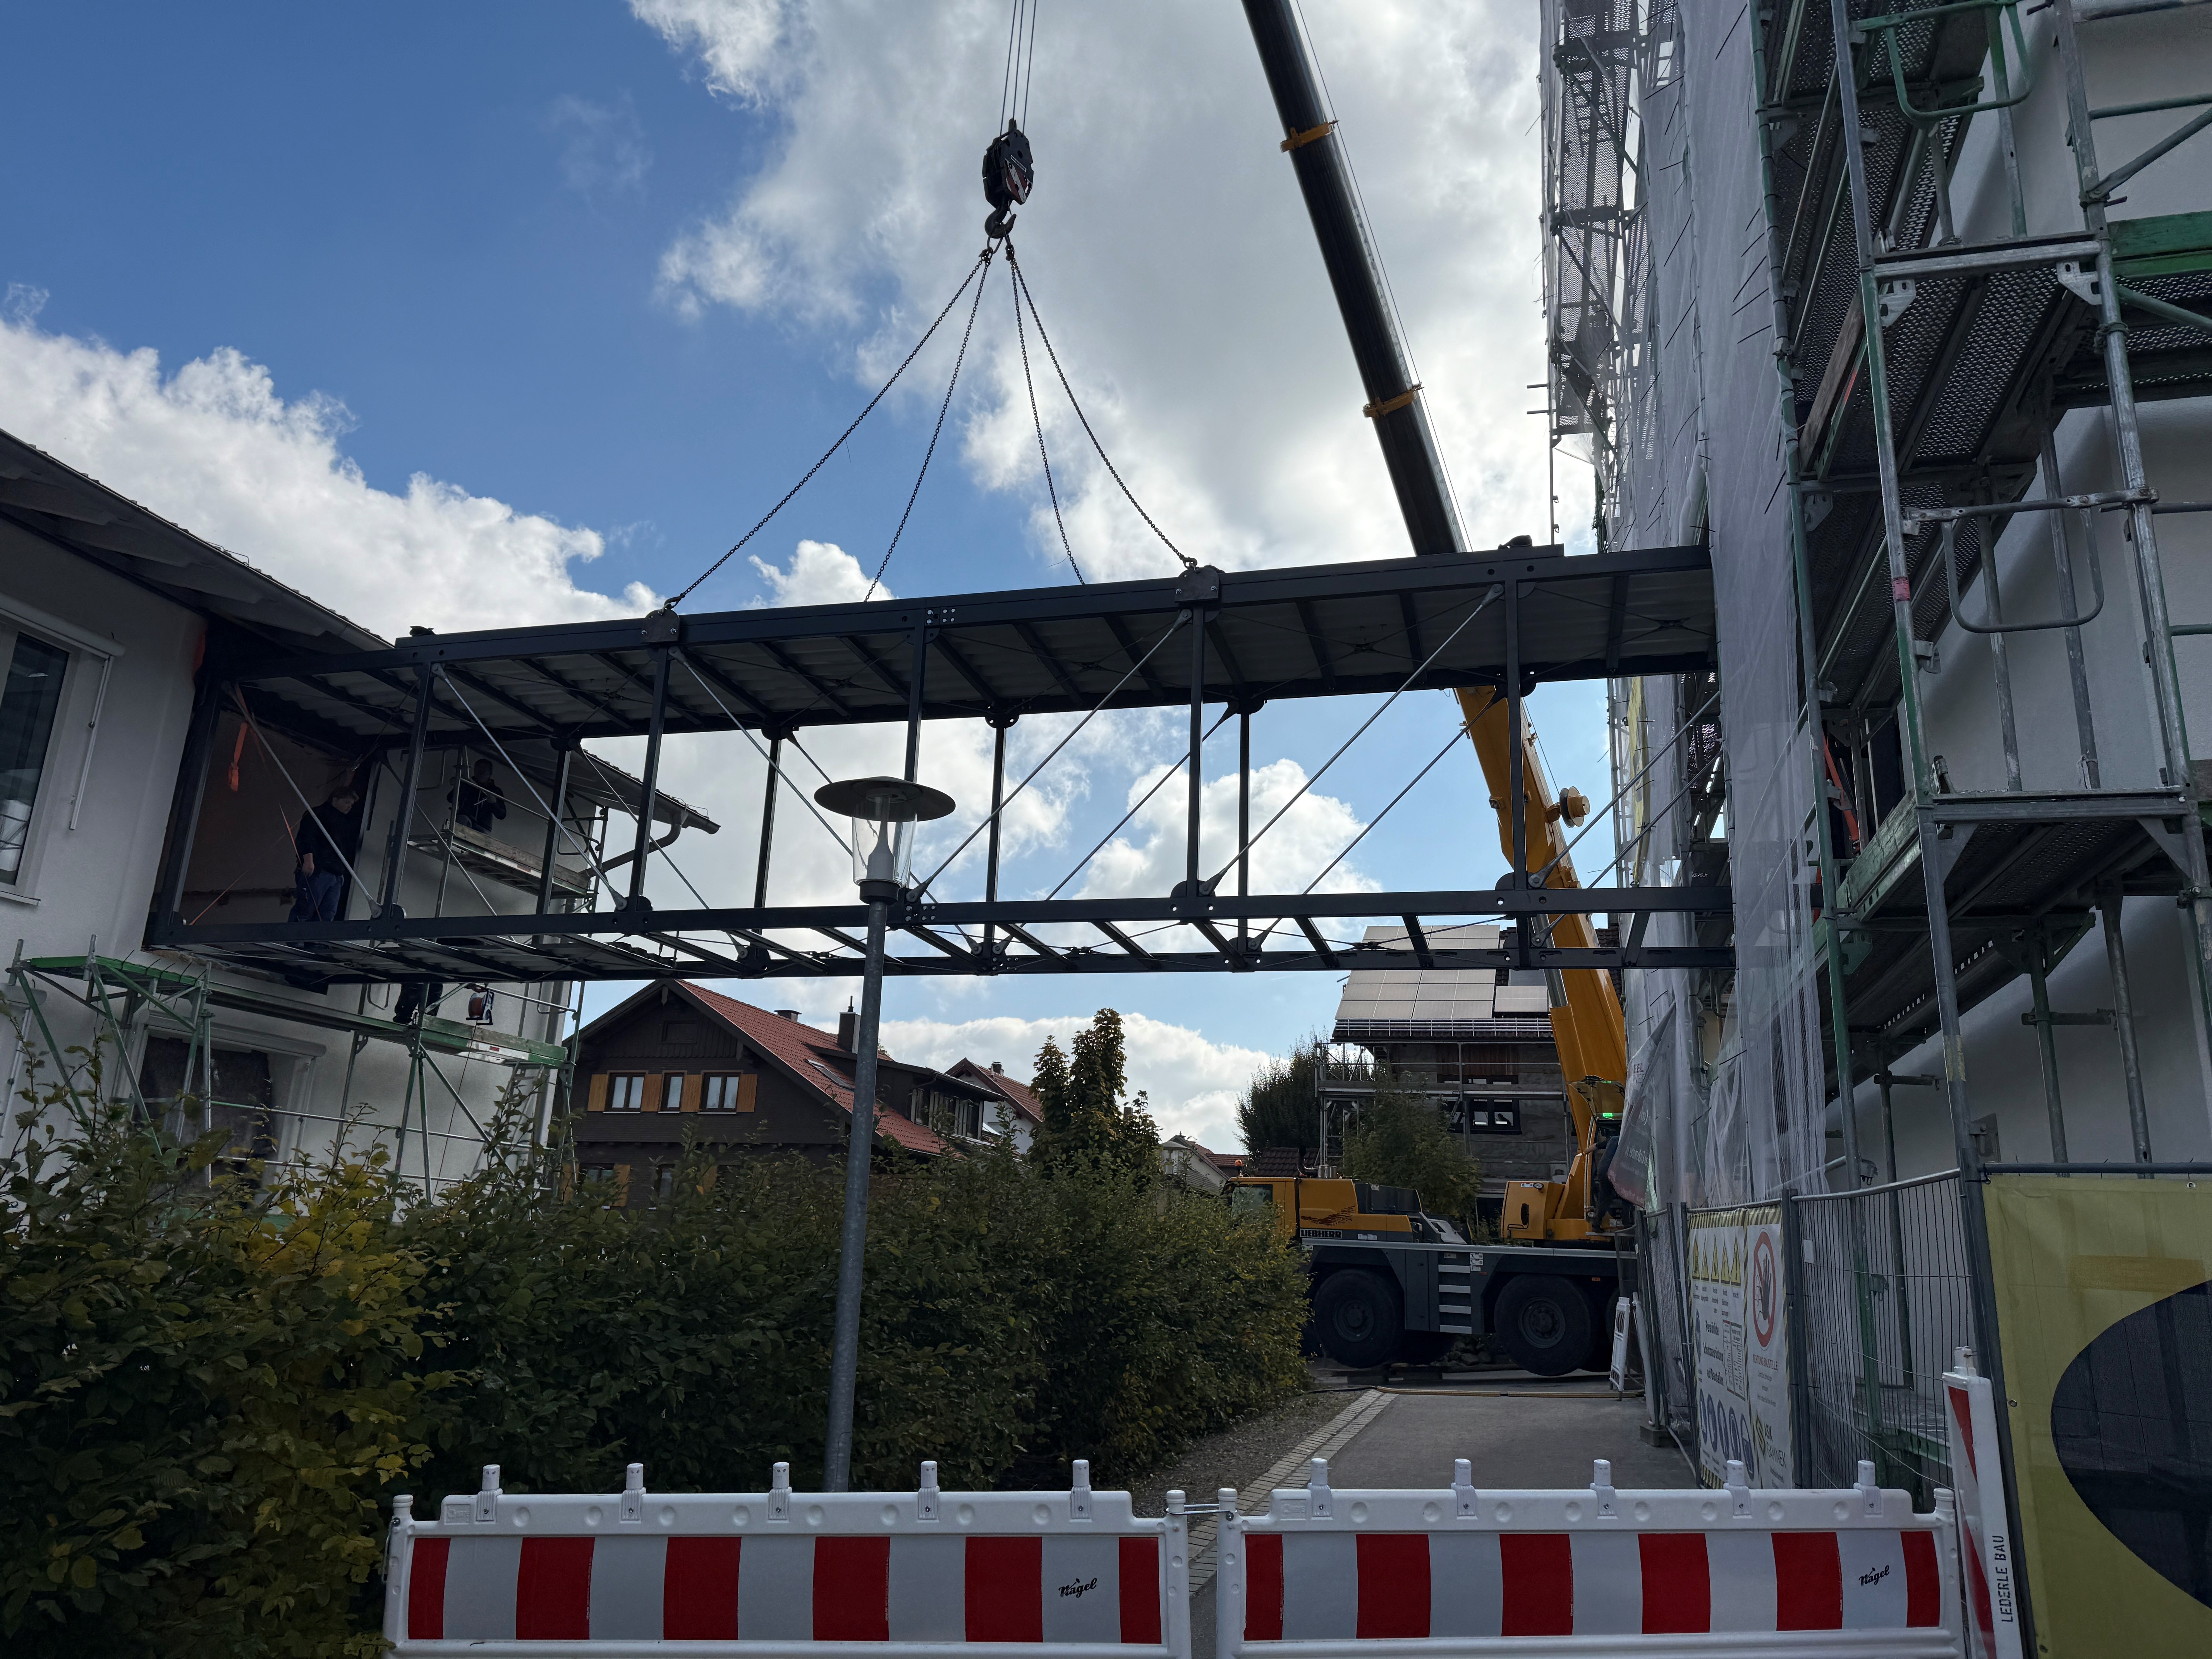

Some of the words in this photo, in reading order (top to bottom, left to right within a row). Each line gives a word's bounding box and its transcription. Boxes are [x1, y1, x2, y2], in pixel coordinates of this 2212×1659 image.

[1301, 1229, 1341, 1238] LIEBHERR
[1992, 1535, 2006, 1561] BAU
[1995, 1567, 2013, 1622] LEDERLE
